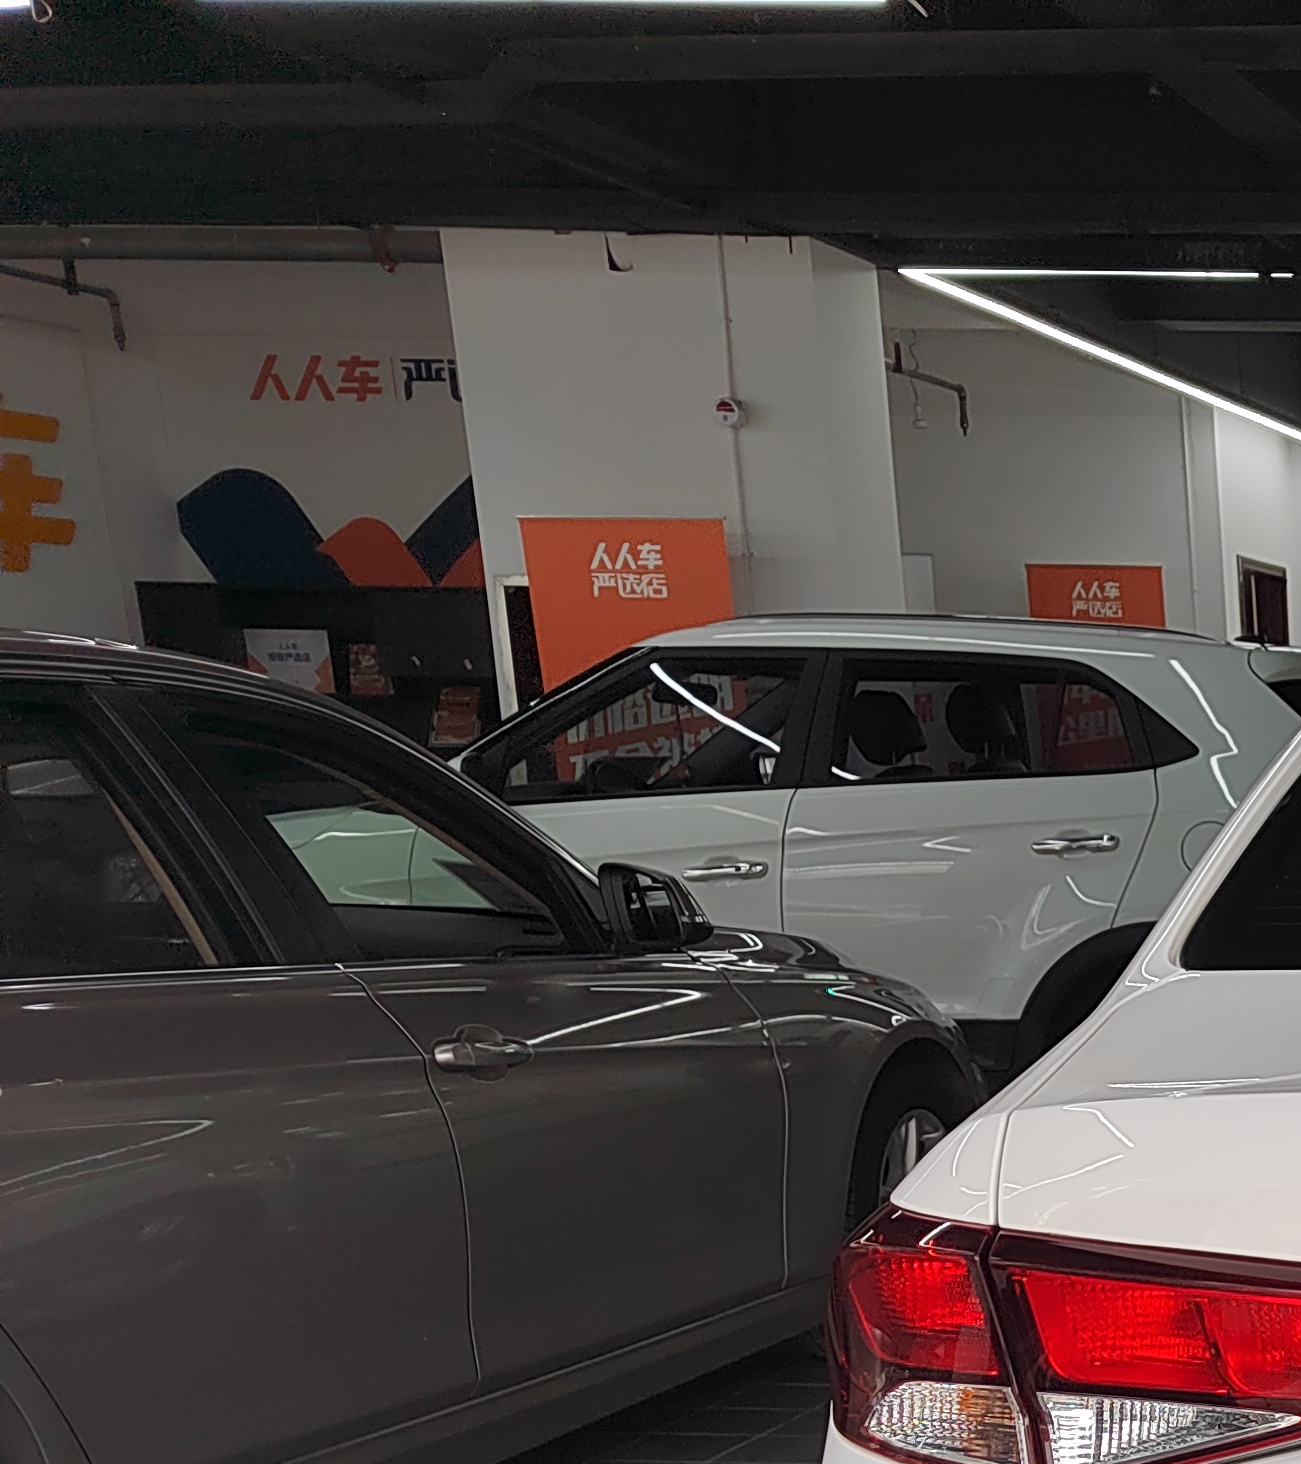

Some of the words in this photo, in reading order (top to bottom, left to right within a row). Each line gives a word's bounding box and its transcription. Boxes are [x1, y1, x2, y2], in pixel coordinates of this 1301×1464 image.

[250, 354, 383, 402] 人人车
[590, 542, 664, 570] 人人车
[591, 572, 668, 598] 严选店
[1072, 580, 1121, 599] 人人车
